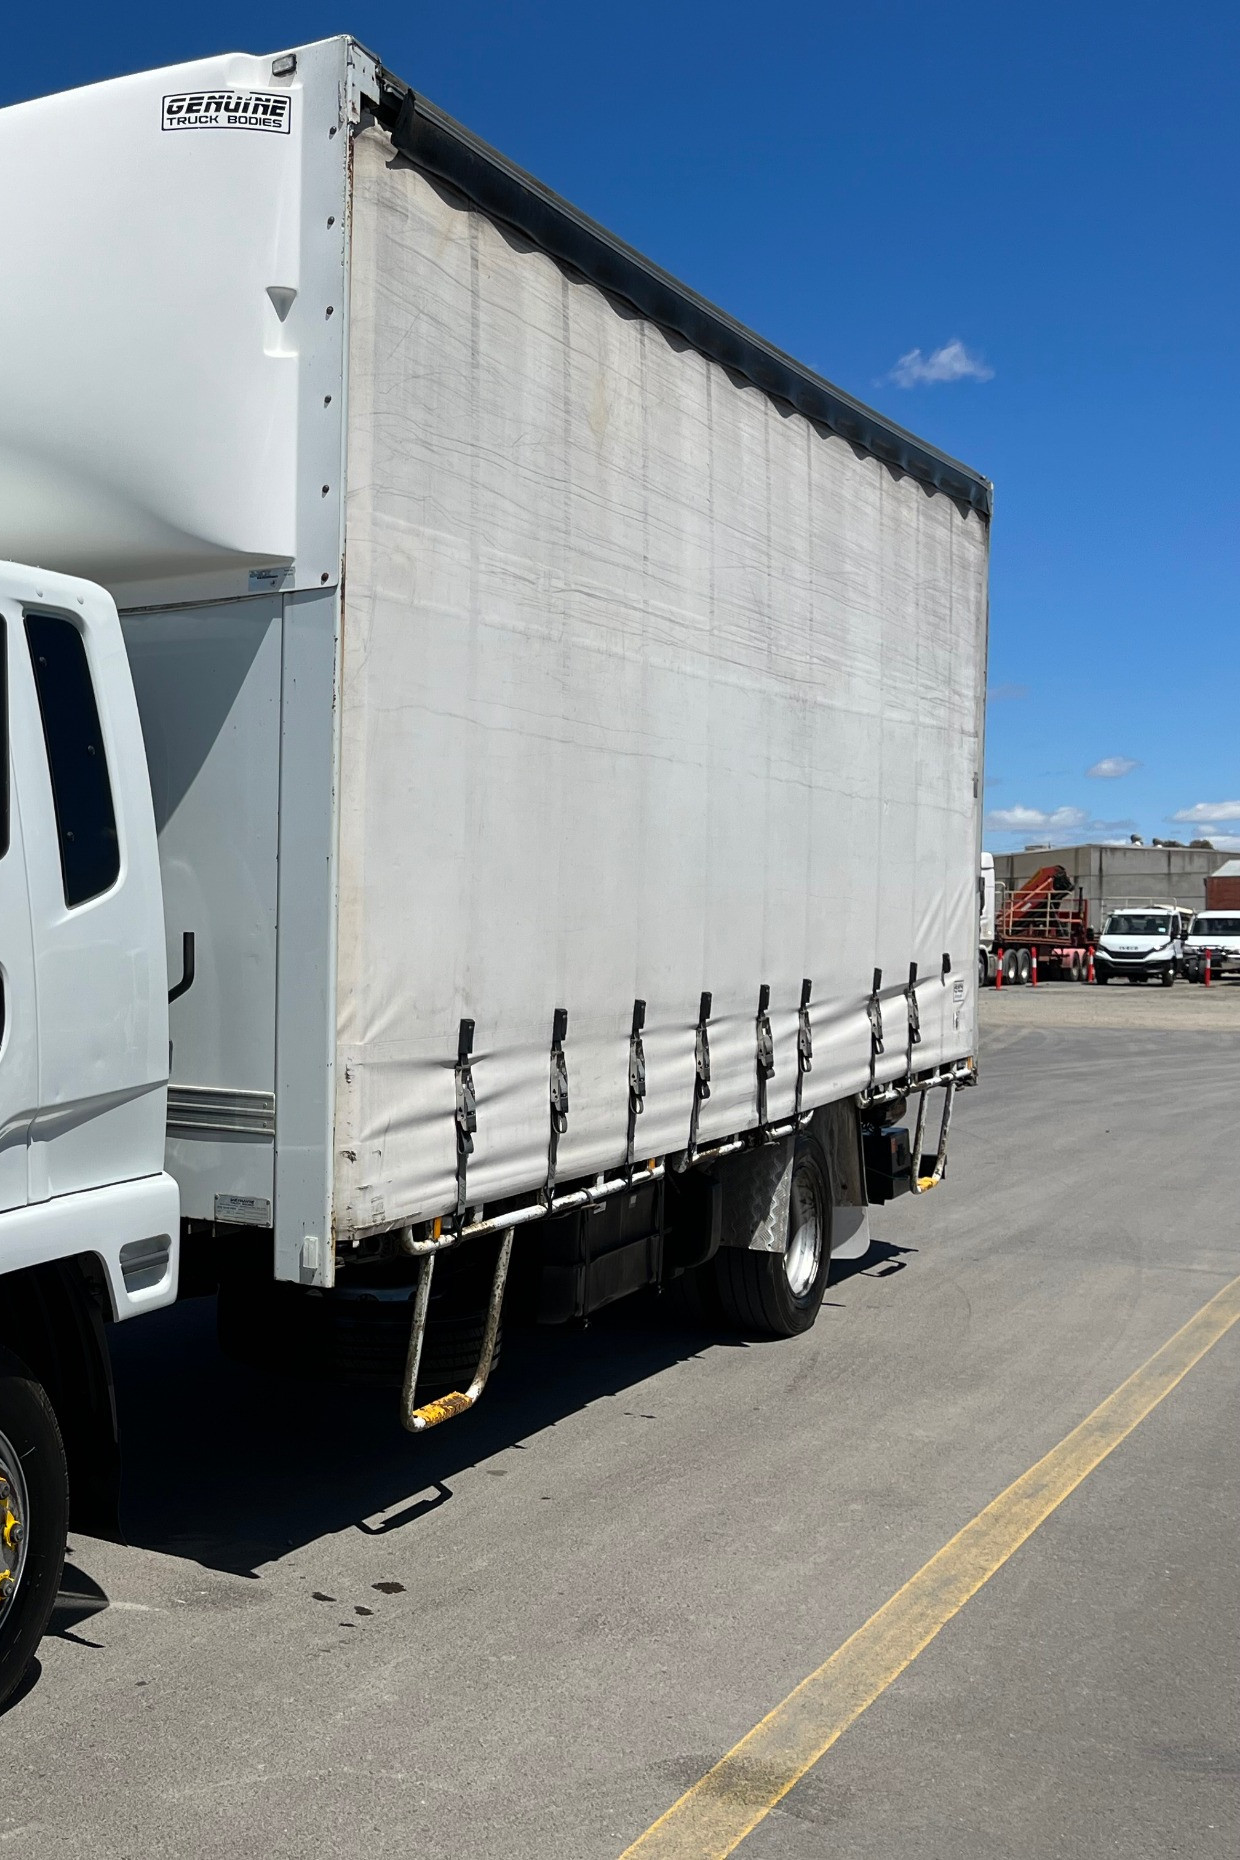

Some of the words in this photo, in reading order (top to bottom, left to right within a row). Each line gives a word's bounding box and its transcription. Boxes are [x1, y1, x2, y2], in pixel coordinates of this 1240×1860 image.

[166, 94, 288, 117] GENUINE
[166, 115, 219, 126] TRUCK
[227, 115, 283, 128] BODIES
